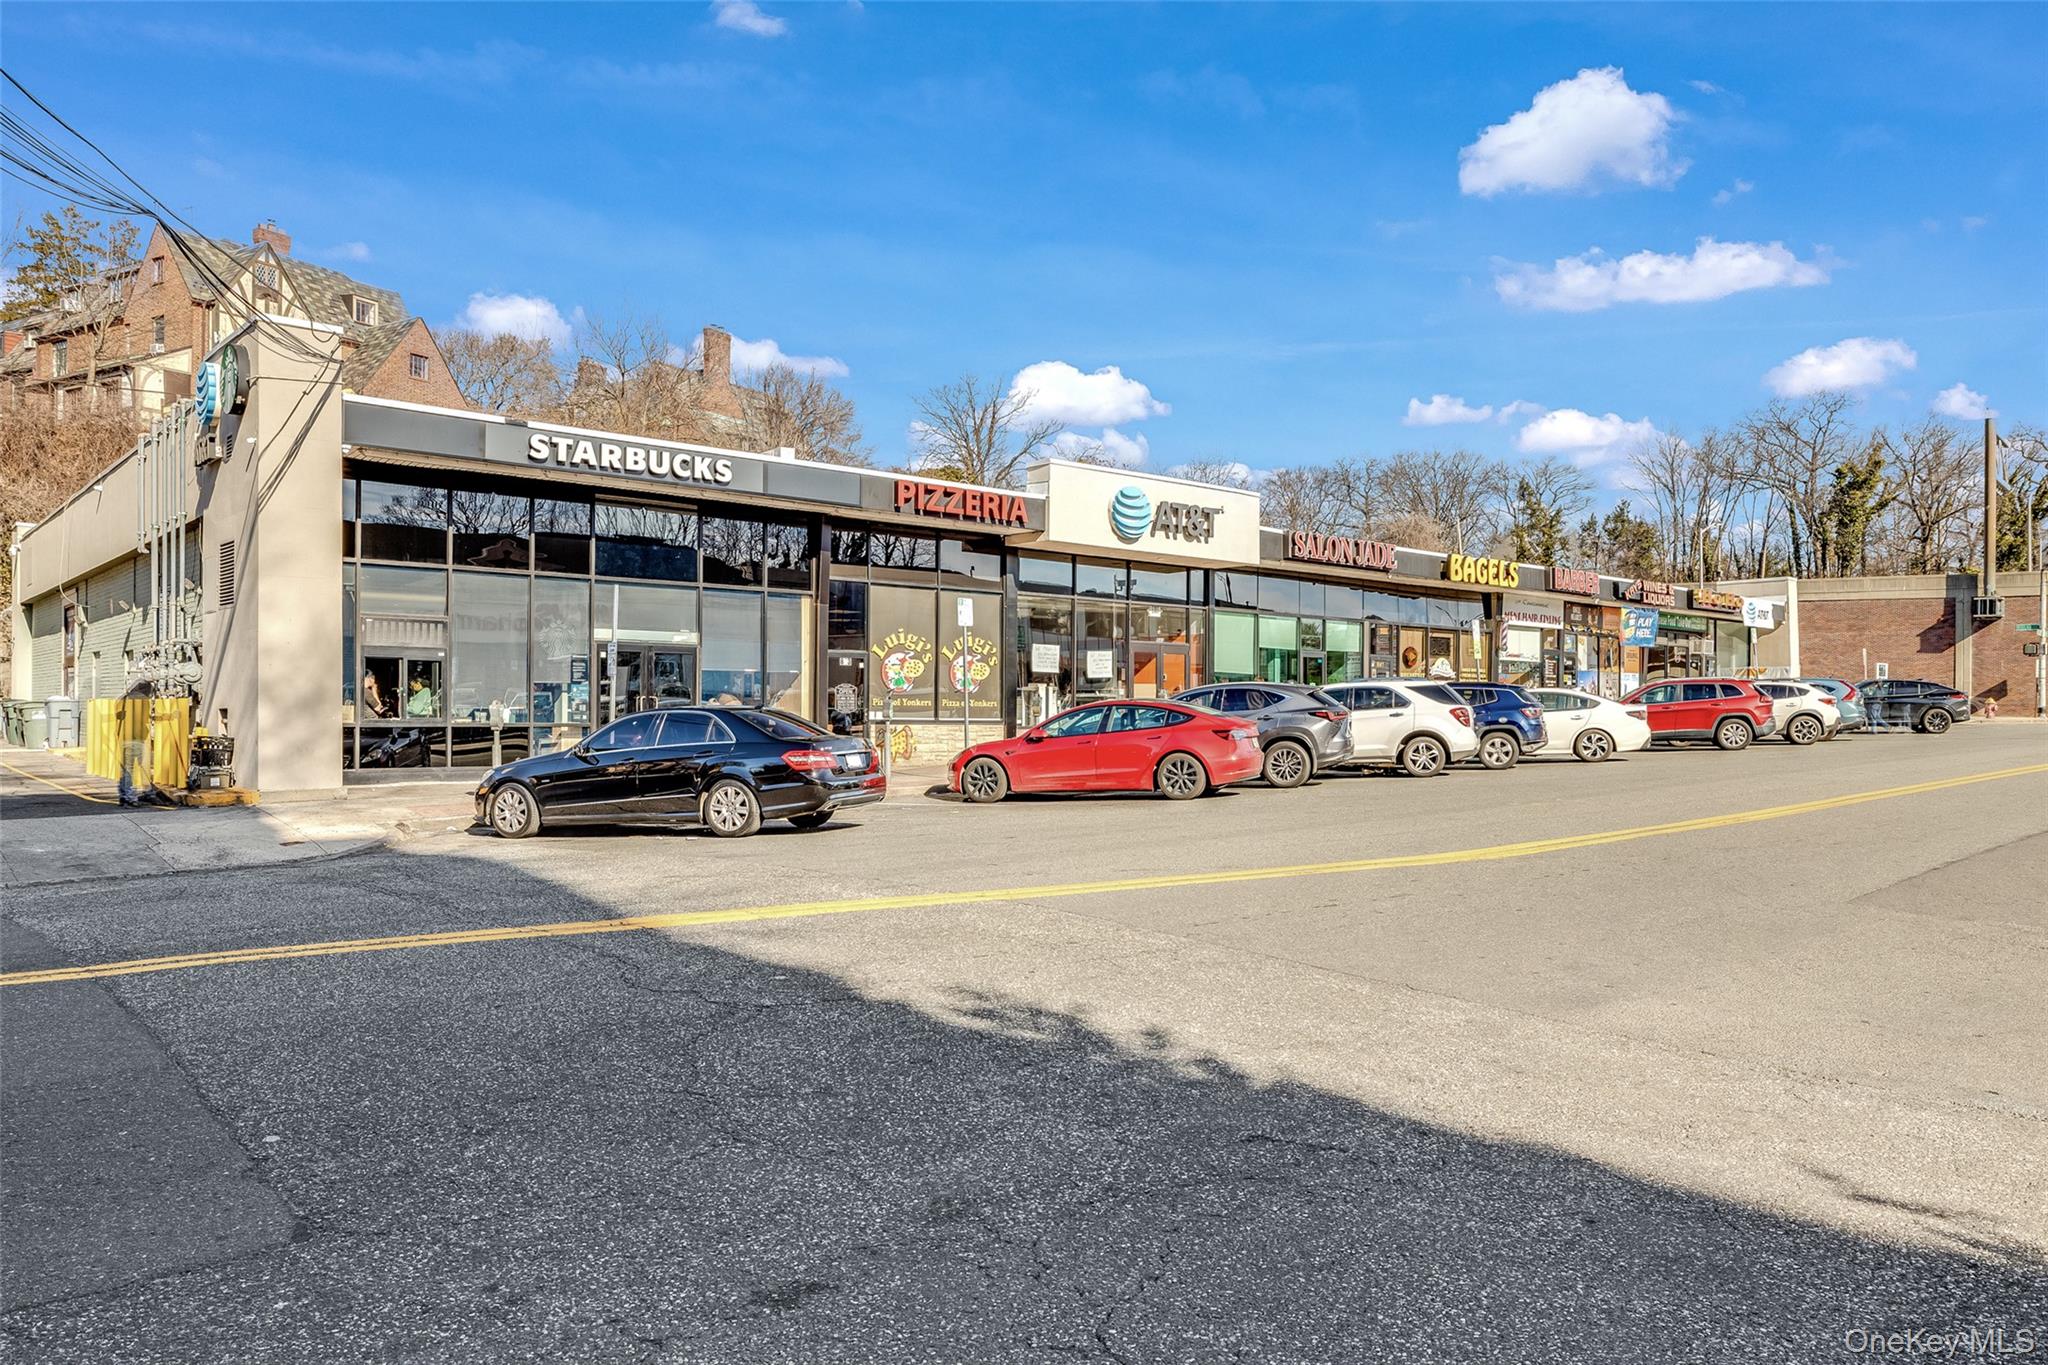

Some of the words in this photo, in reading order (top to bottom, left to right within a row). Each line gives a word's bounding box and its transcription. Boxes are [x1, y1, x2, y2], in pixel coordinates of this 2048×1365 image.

[528, 433, 733, 485] STARBUCKS
[894, 479, 1029, 525] PIZZERIA
[1152, 500, 1219, 542] AT&T
[1294, 530, 1354, 565] SALON
[1355, 538, 1398, 570] JADE
[1450, 553, 1520, 588] BAGELS
[1554, 566, 1600, 595] BARBER
[1642, 580, 1668, 594] WINES
[1668, 583, 1675, 595] &
[1642, 591, 1676, 607] LIQUORS
[1637, 617, 1654, 628] PLAY
[871, 628, 933, 664] Luigi's
[941, 632, 998, 667] Luigi's
[902, 698, 932, 707] Yonkers
[941, 698, 960, 707] Pizza
[969, 698, 998, 707] Yonkers
